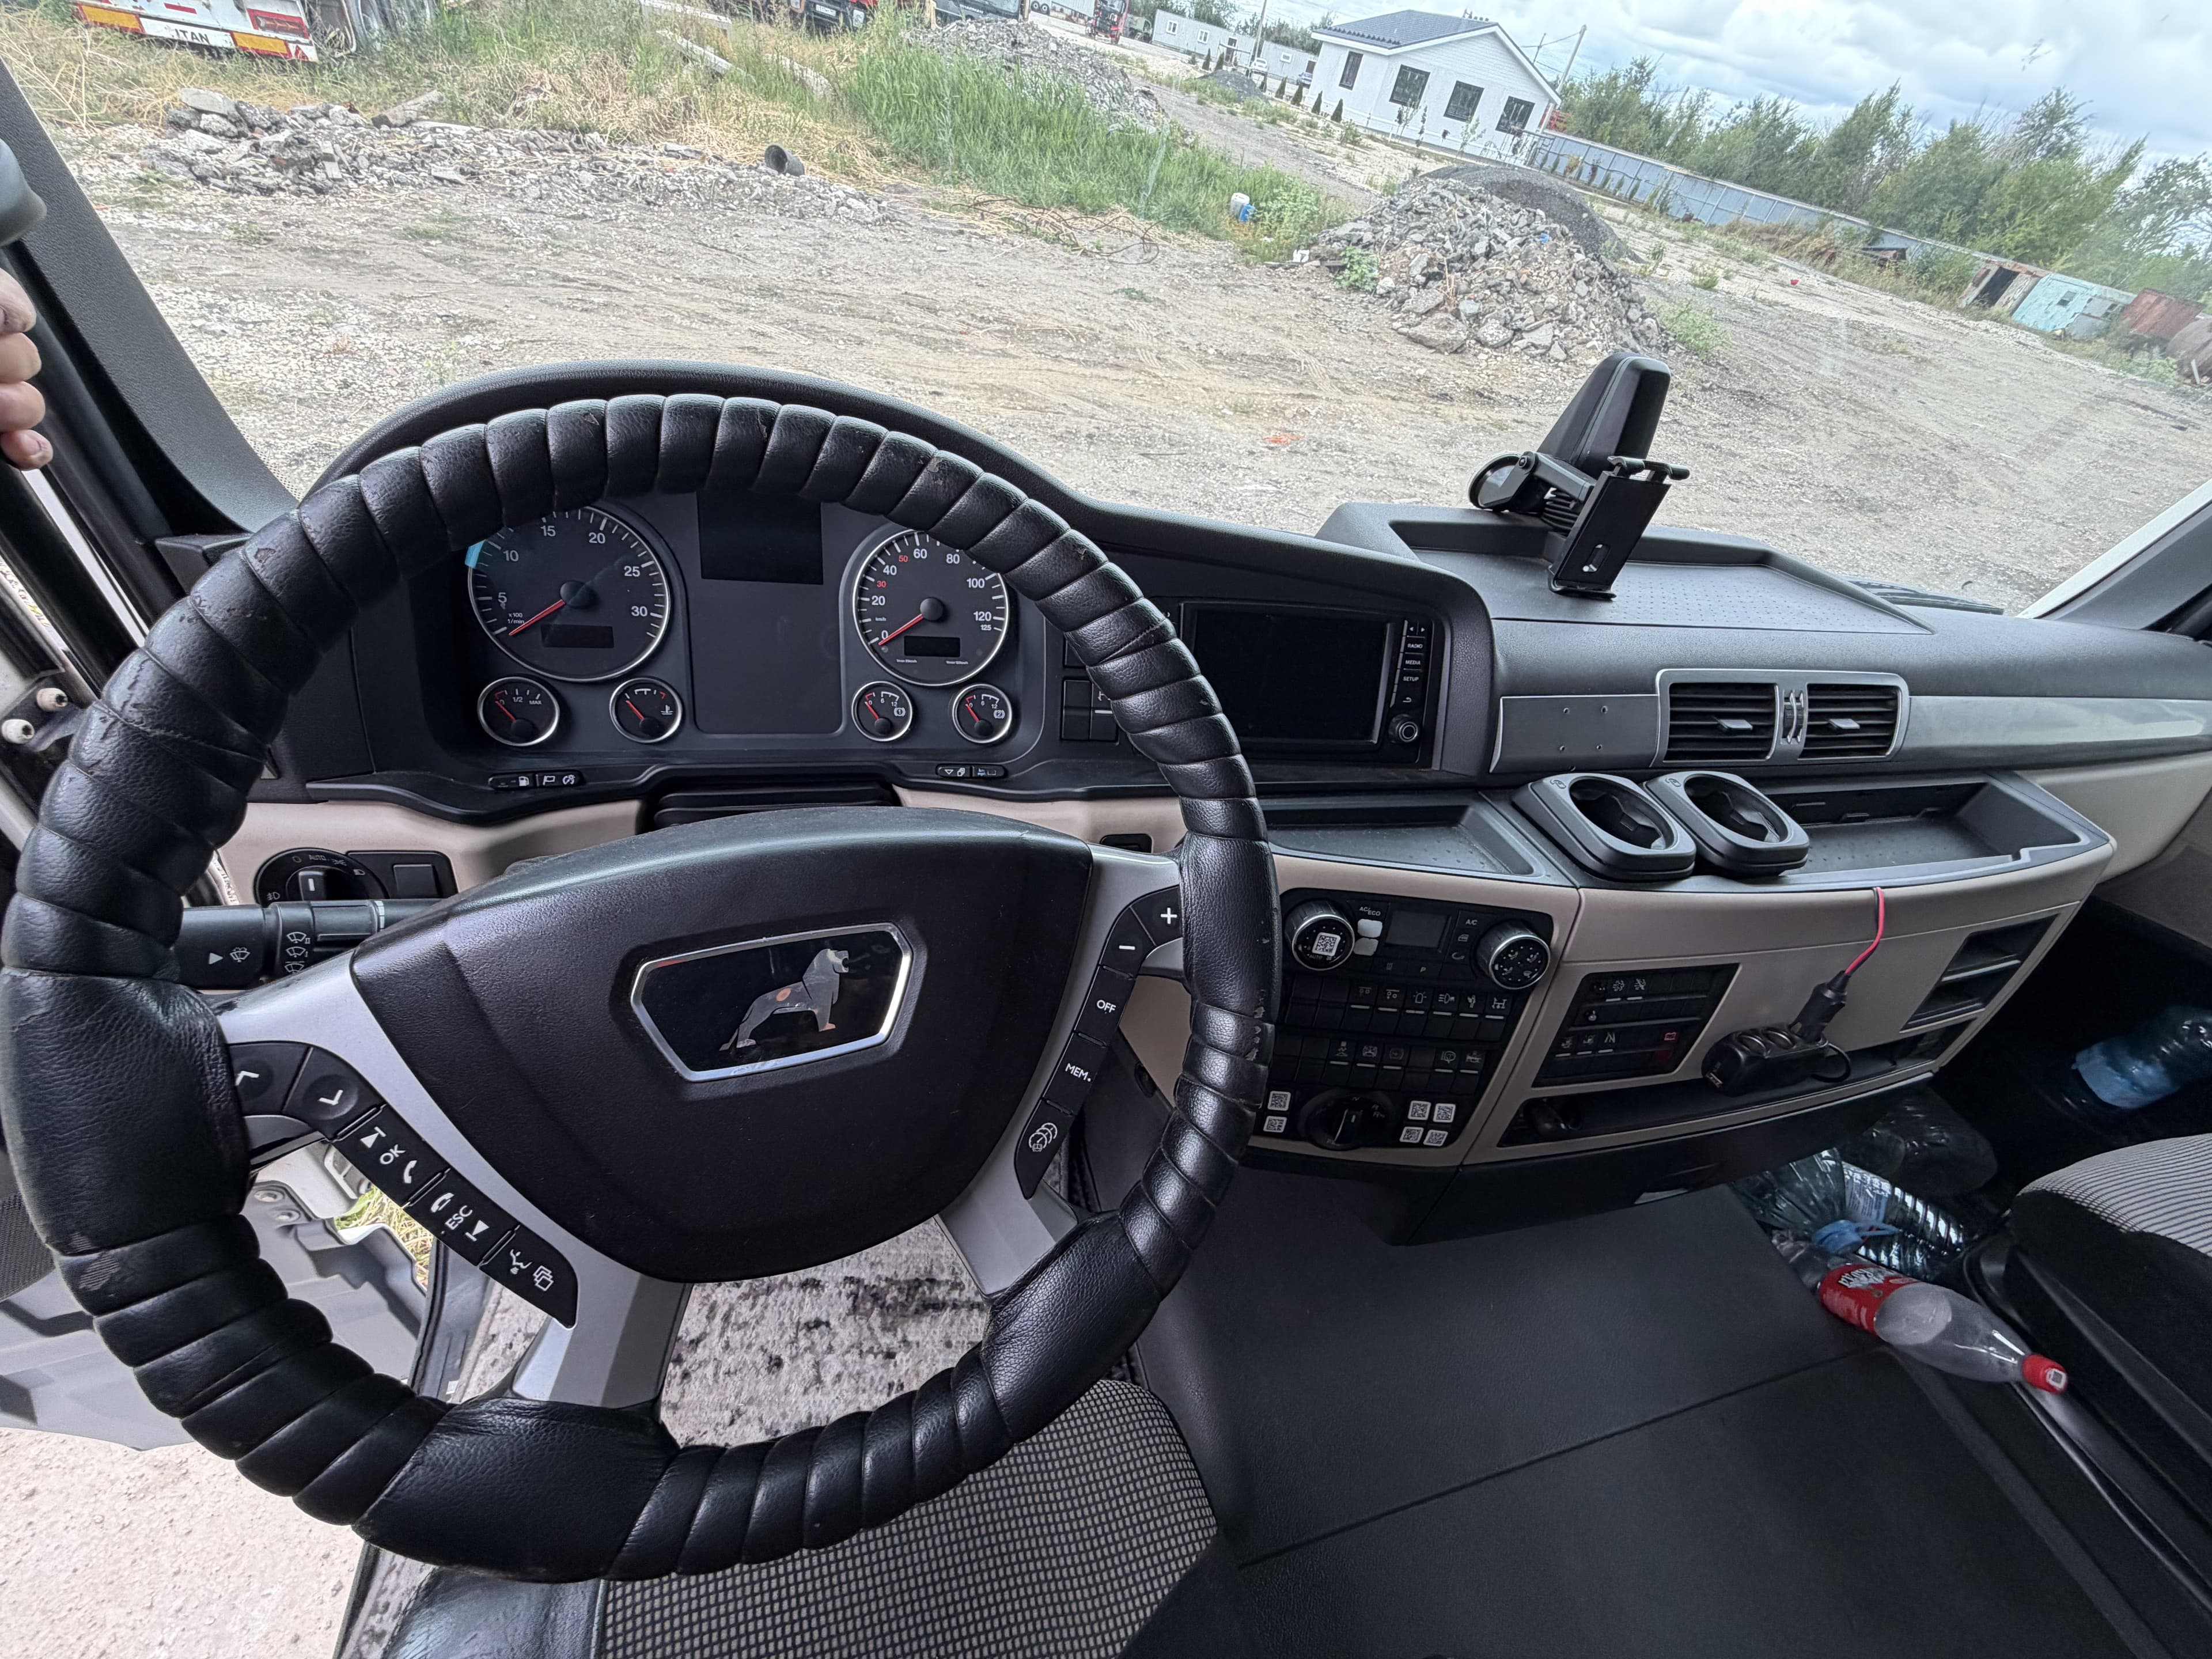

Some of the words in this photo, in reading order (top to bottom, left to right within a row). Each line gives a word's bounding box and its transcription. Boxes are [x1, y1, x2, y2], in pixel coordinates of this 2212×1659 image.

[540, 525, 556, 537] 15
[588, 532, 605, 544] 20
[503, 550, 518, 562] 10
[913, 548, 927, 559] 60
[946, 554, 960, 564] 80
[624, 566, 640, 577] 25
[882, 565, 897, 575] 40
[877, 580, 887, 588] 30
[966, 577, 985, 589] 100
[497, 592, 507, 604] 5
[871, 595, 886, 606] 20
[631, 606, 648, 617] 30
[973, 611, 992, 622] 120
[881, 630, 889, 640] 0
[1096, 999, 1117, 1013] OFF
[379, 1143, 406, 1165] OK
[445, 1205, 473, 1230] ESC
